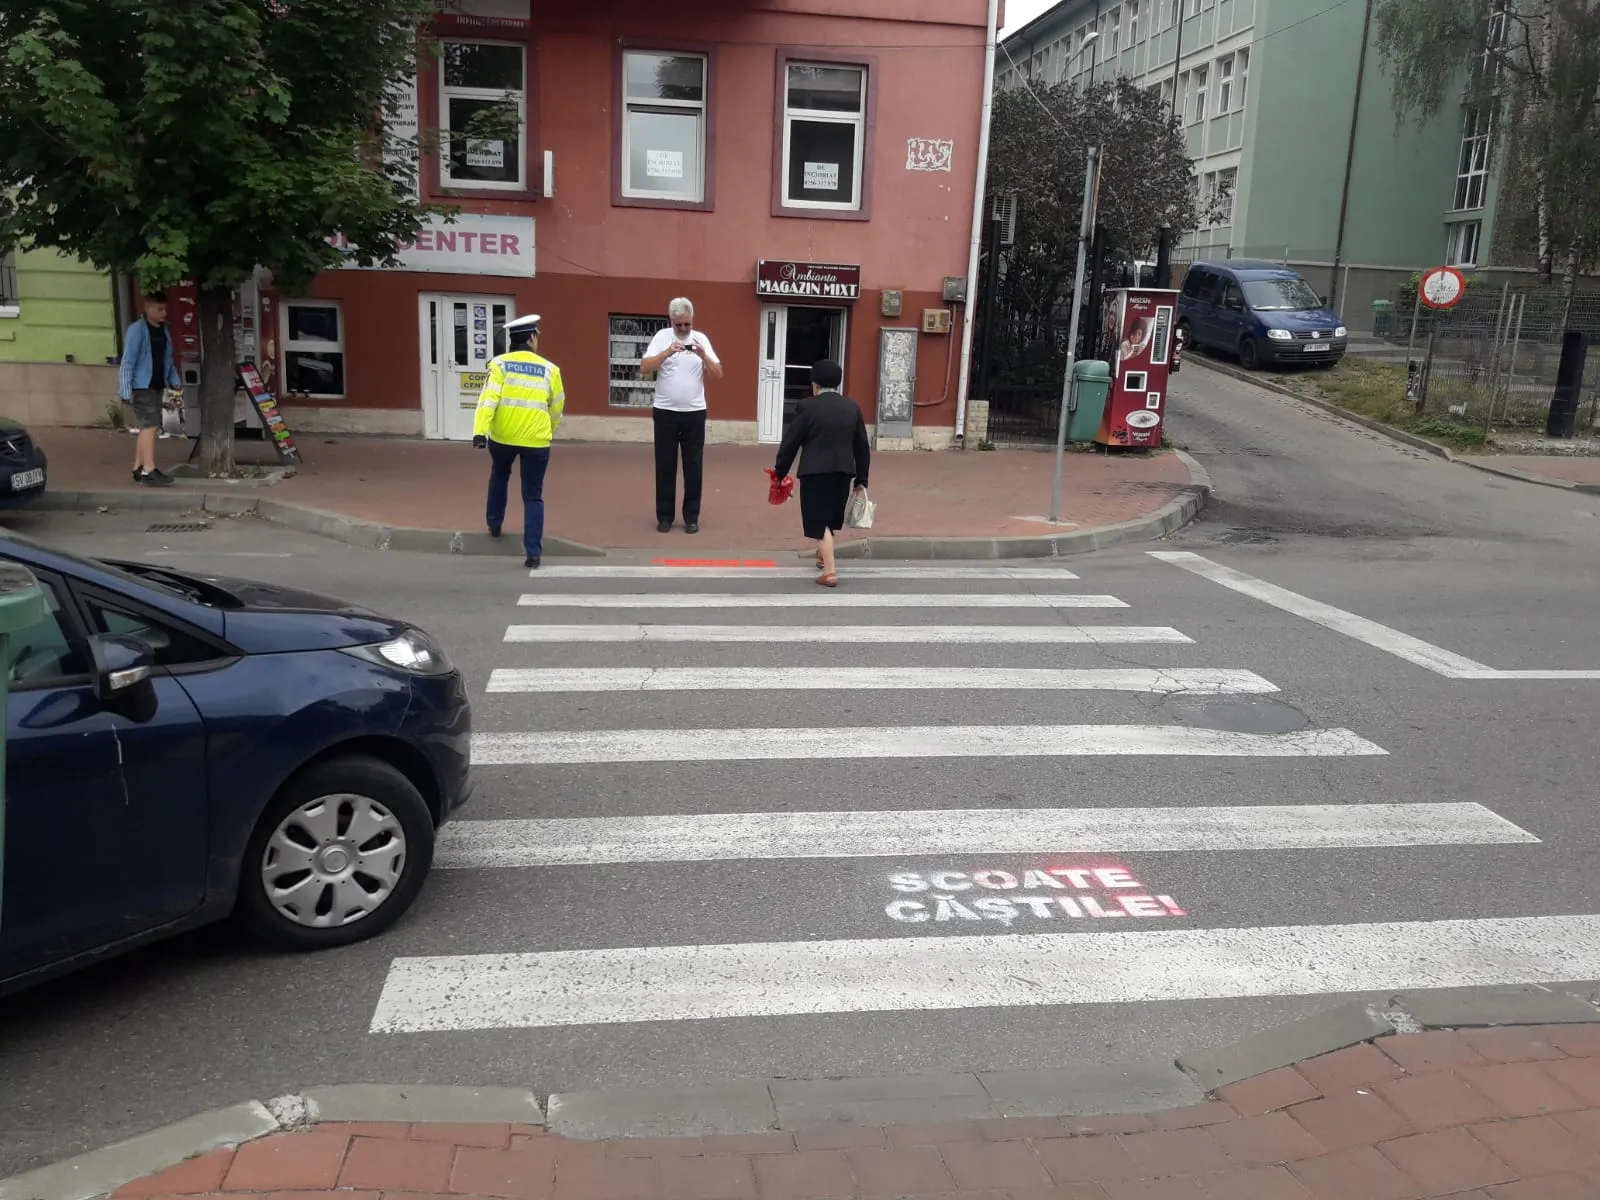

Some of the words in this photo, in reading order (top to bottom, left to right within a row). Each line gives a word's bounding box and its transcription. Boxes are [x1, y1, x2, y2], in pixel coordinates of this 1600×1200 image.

[759, 279, 820, 295] MAGAZIN
[824, 283, 858, 297] MIXT
[887, 866, 1142, 892] SCOATE
